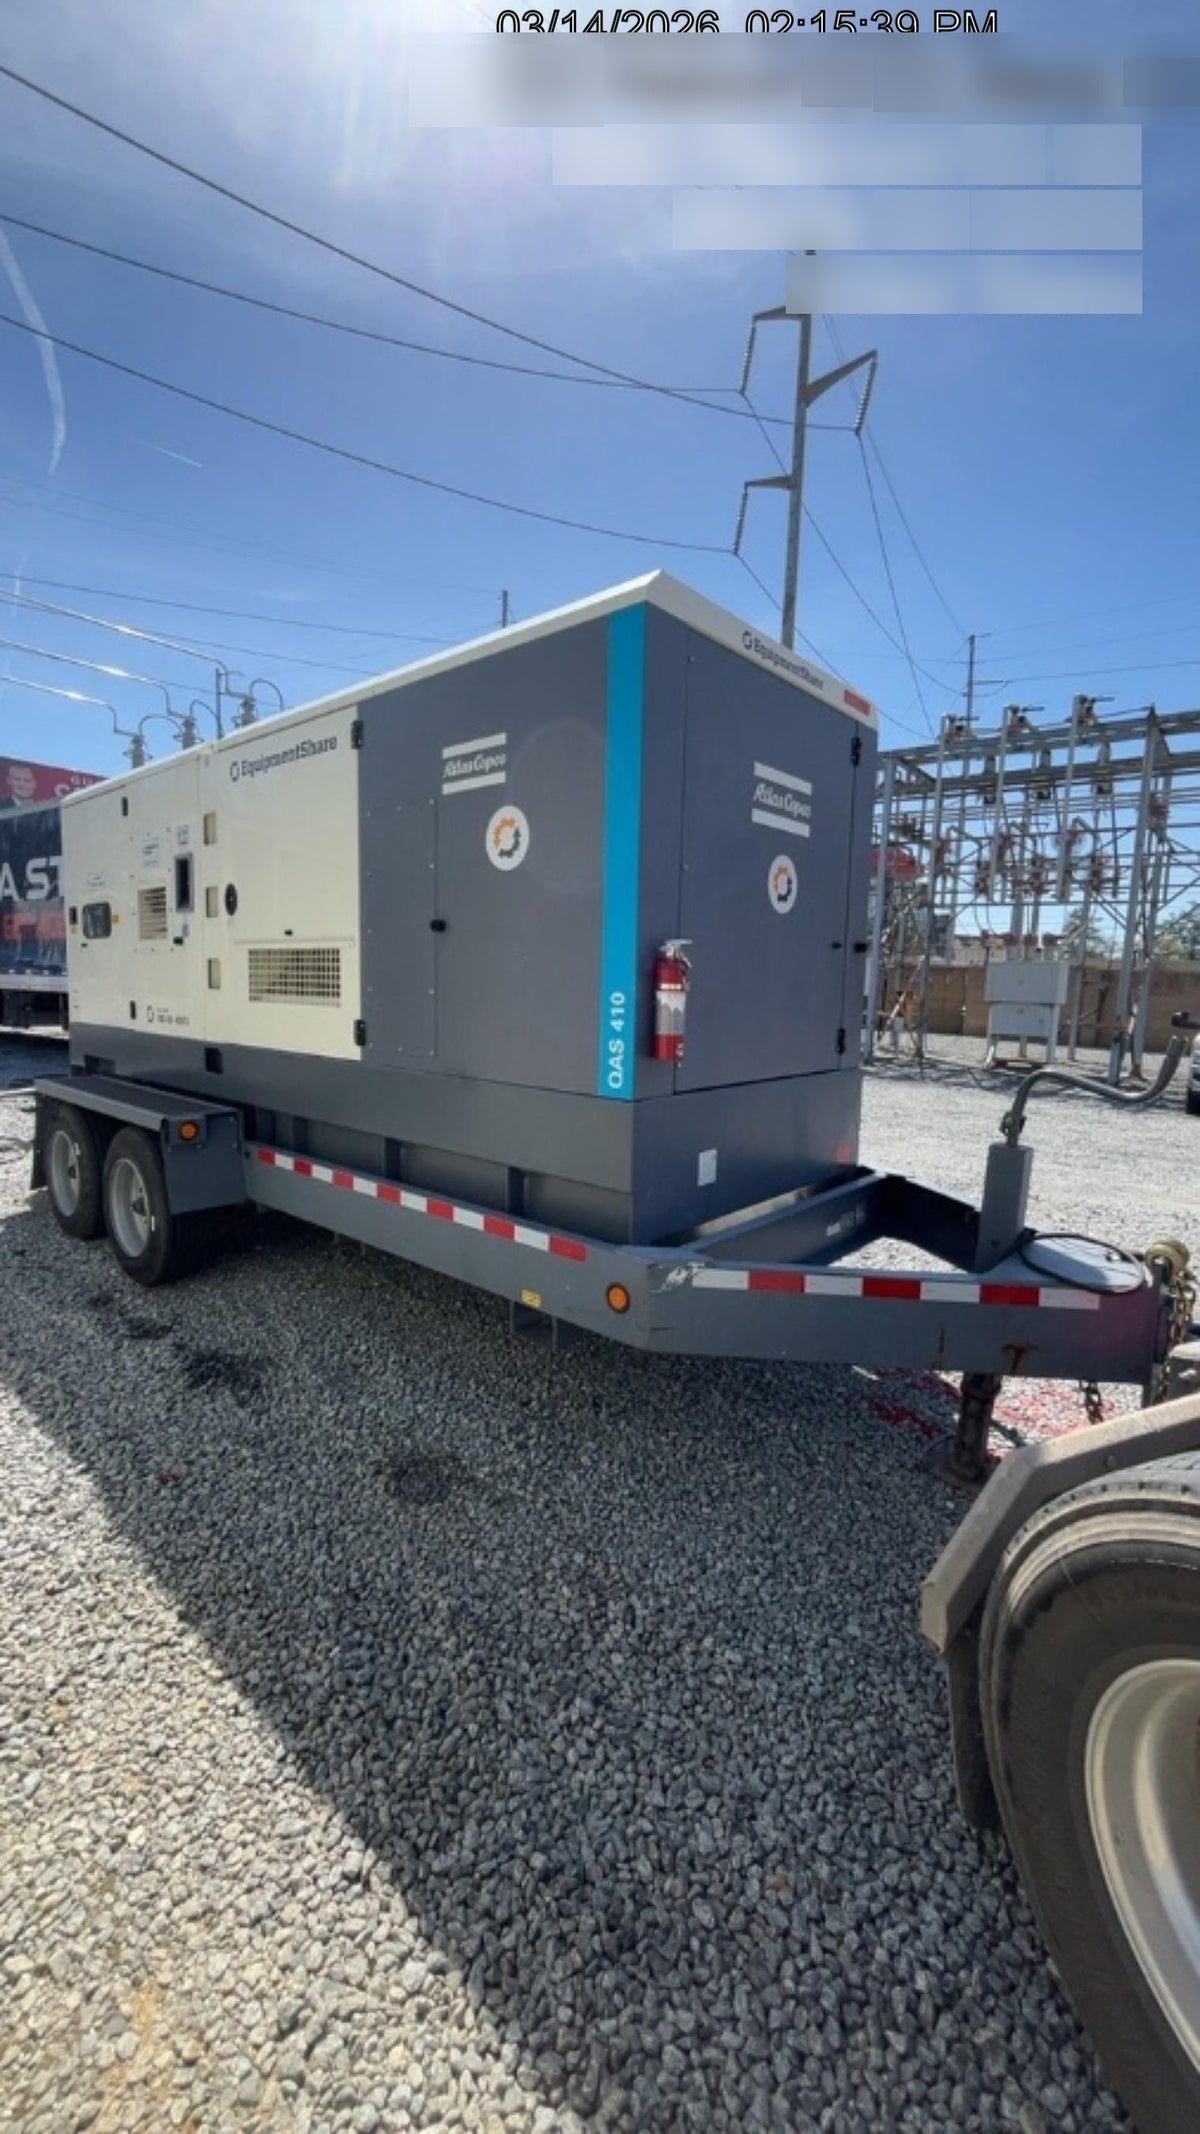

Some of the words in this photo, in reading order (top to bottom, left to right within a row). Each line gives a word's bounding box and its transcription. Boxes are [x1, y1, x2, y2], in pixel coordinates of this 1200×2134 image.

[241, 736, 338, 778] EquipmentShare
[610, 992, 625, 1032] 410
[608, 1038, 625, 1089] QAS
